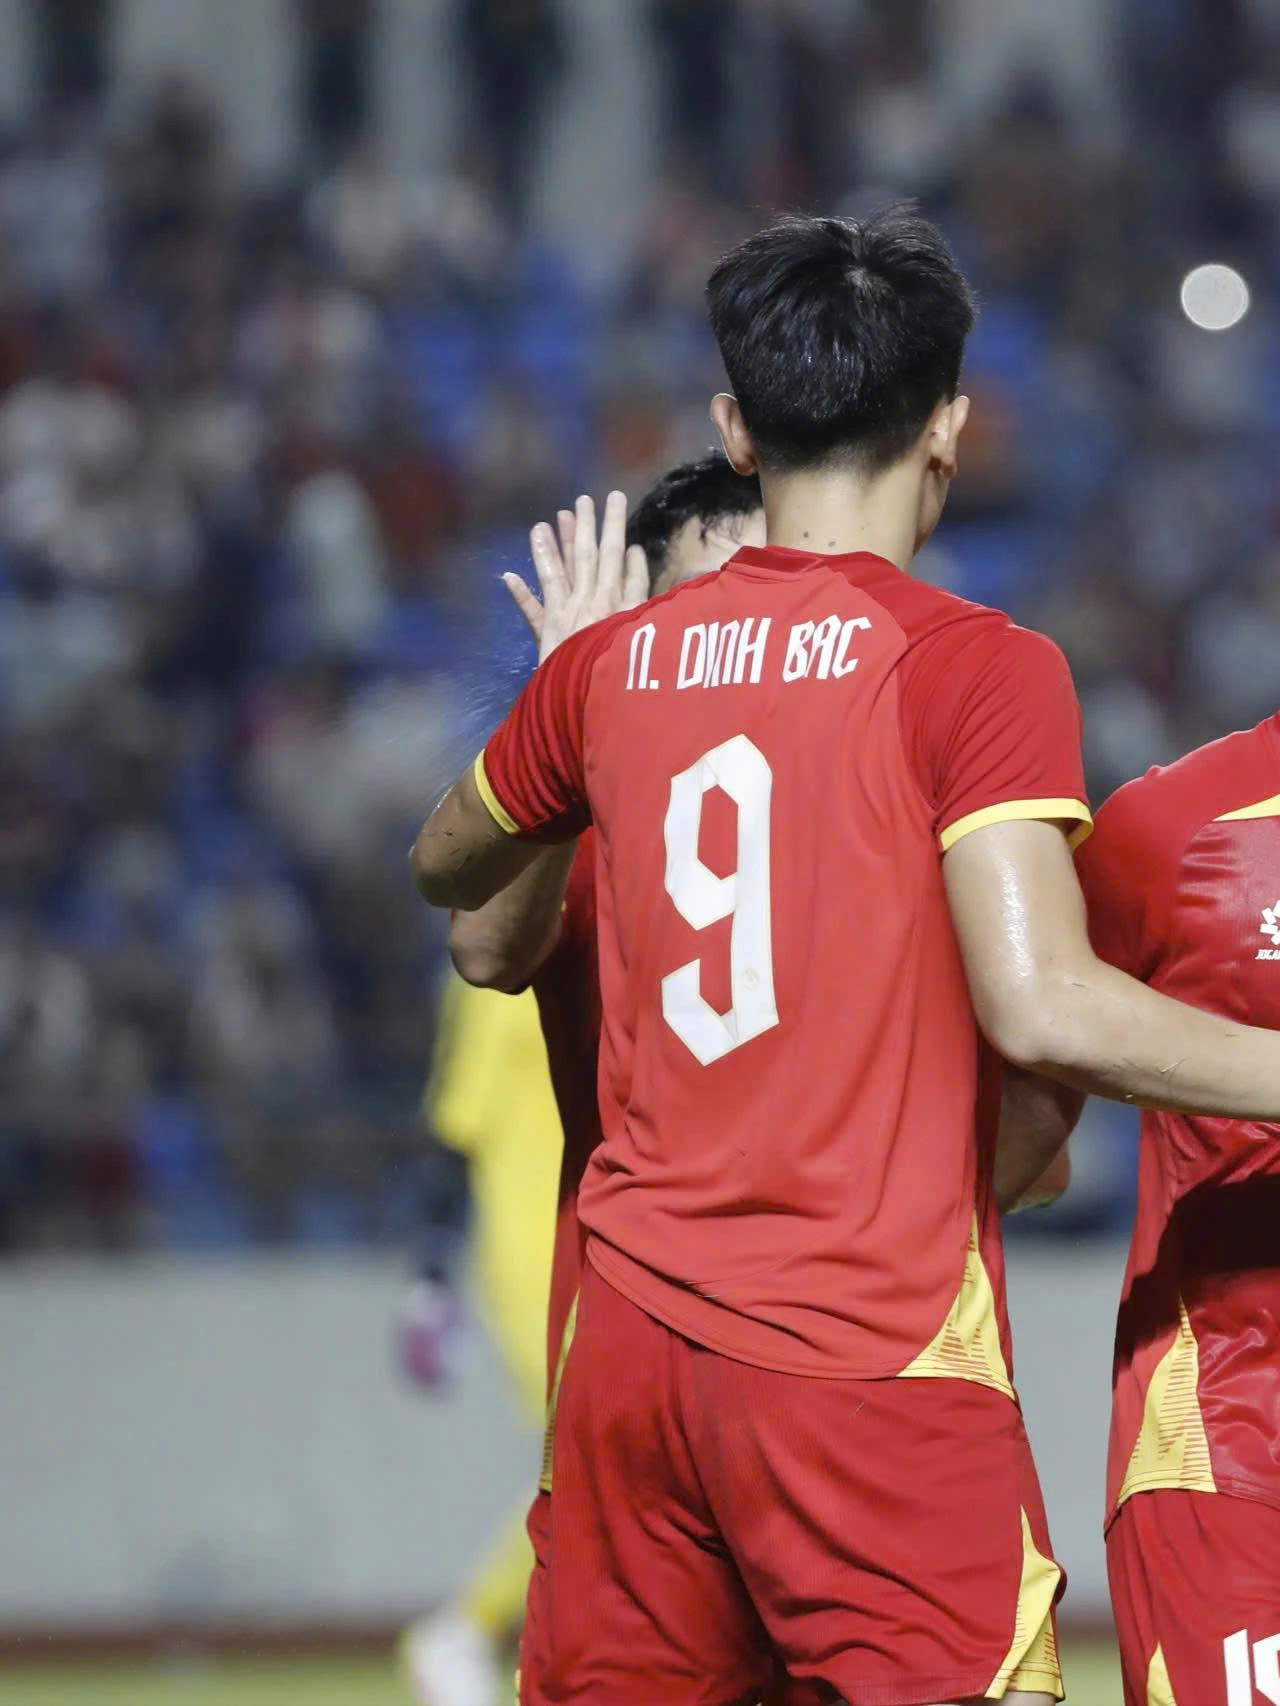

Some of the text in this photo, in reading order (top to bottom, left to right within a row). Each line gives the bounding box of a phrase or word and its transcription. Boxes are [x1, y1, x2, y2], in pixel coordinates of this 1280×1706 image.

[676, 617, 772, 690] DINH
[782, 614, 872, 683] BAC
[661, 733, 780, 1067] 9
